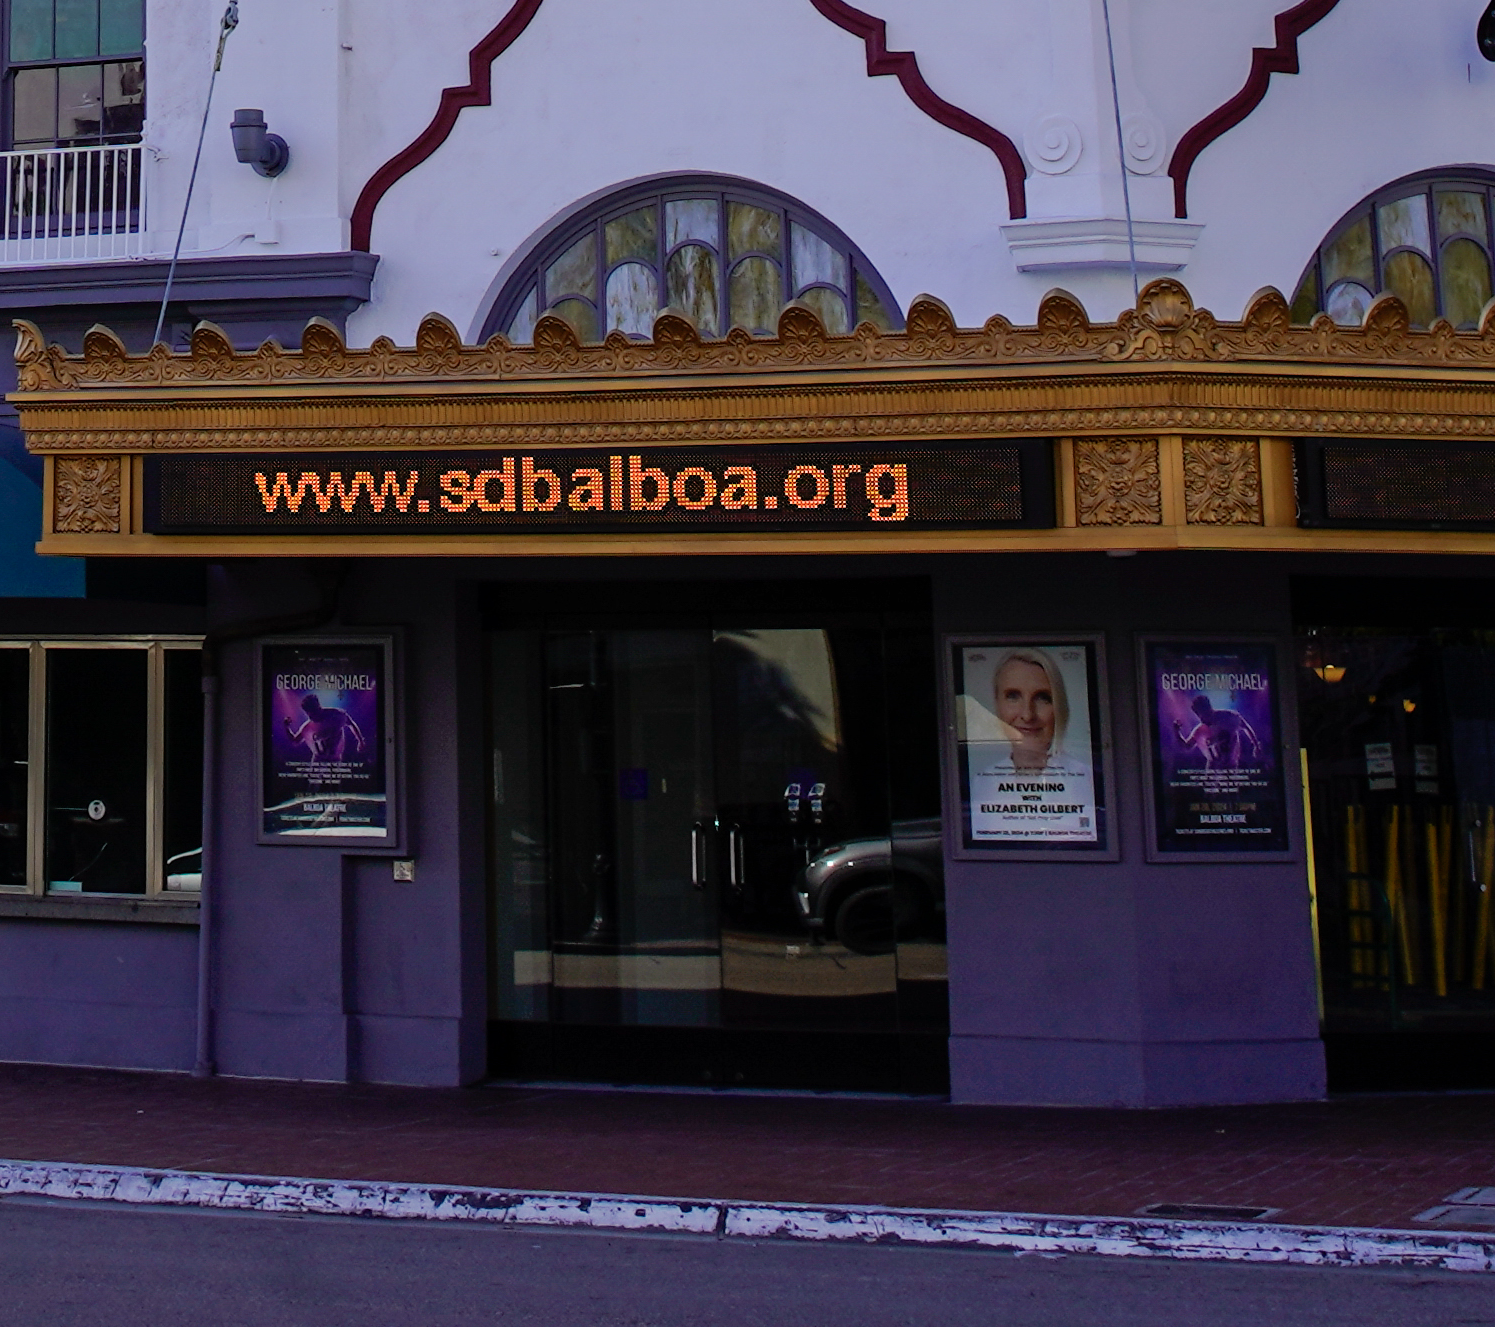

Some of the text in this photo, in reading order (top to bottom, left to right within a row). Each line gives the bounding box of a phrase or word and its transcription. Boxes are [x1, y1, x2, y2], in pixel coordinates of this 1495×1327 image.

[255, 455, 909, 521] www.sdbalboa.org
[276, 674, 372, 691] GEORGE MICHAEL
[1161, 673, 1265, 691] GEORGE MICHAEL
[997, 783, 1065, 792] AN EVENING
[981, 804, 1085, 814] ELIZABETH GILBERT
